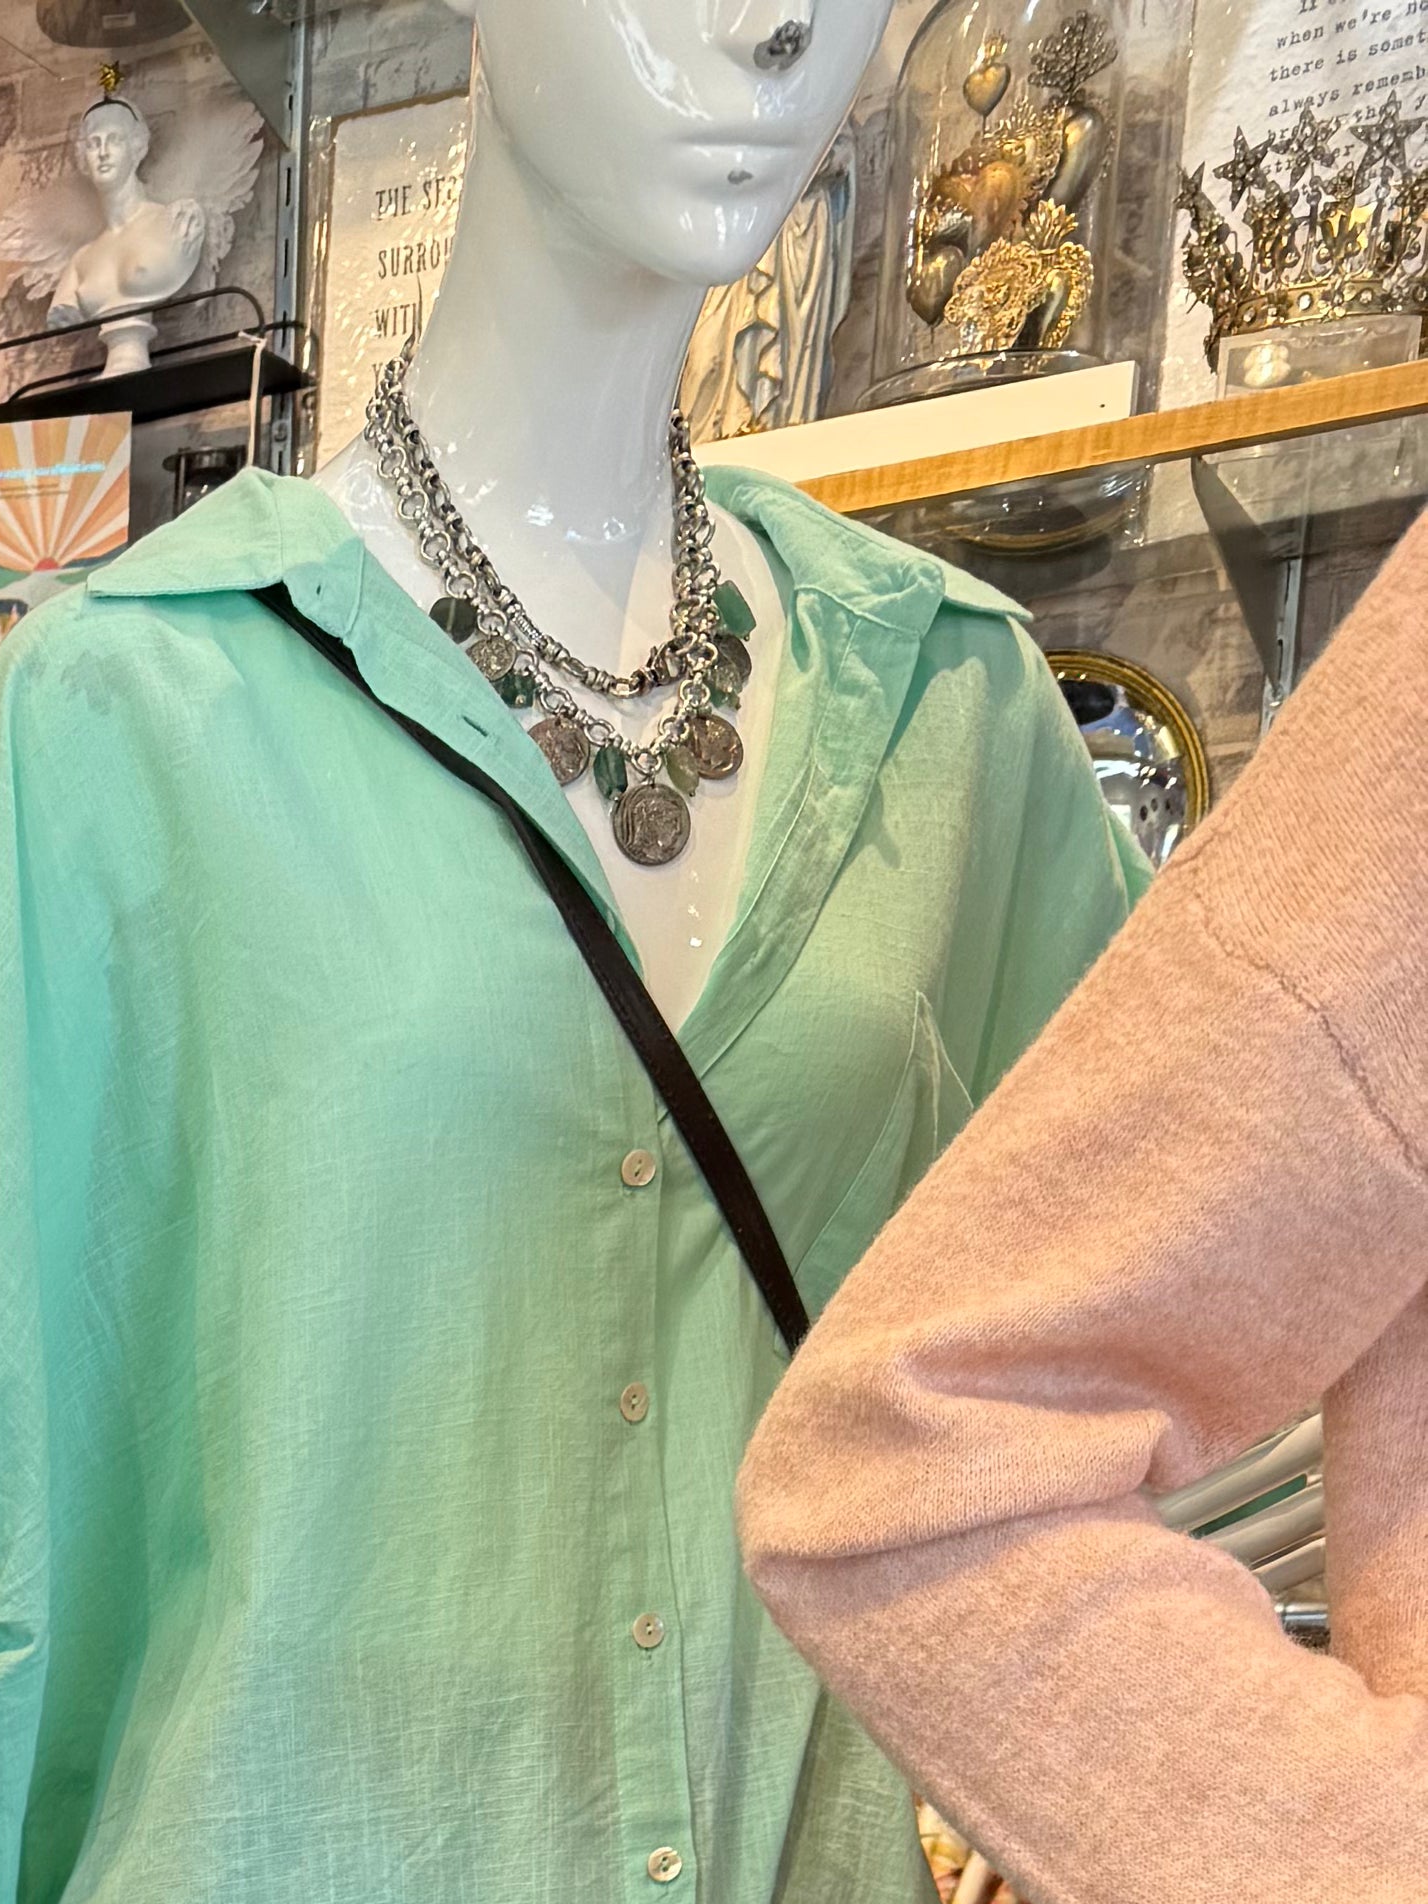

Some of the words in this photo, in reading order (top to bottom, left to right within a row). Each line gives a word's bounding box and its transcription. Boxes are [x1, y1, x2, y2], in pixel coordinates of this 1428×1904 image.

[1276, 25, 1325, 49] when
[1335, 8, 1392, 33] we're
[1269, 57, 1325, 82] there
[1336, 50, 1358, 65] is
[1368, 28, 1428, 57] somet
[1268, 88, 1340, 118] always
[1352, 65, 1428, 95] rememb
[375, 184, 413, 221] THE
